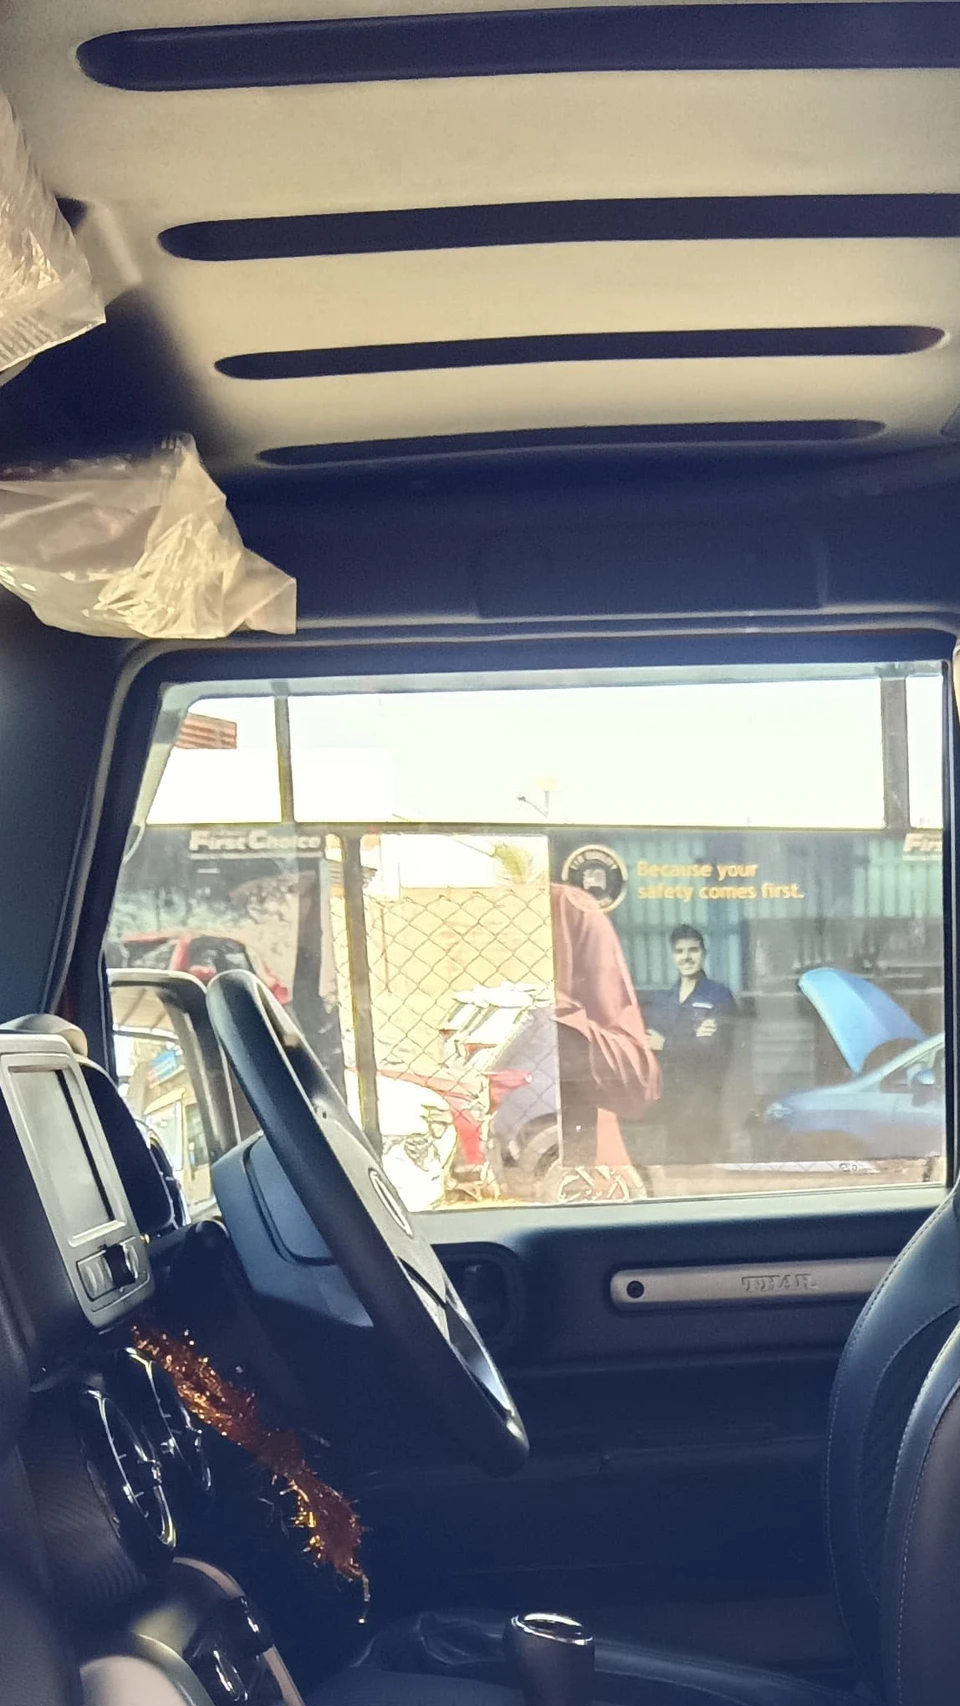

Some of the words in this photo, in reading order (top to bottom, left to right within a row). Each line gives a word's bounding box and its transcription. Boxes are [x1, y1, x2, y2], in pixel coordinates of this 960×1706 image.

[636, 860, 713, 877] Because
[716, 863, 759, 881] your
[637, 884, 694, 902] safety
[698, 885, 758, 899] comes
[760, 882, 806, 899] first.
